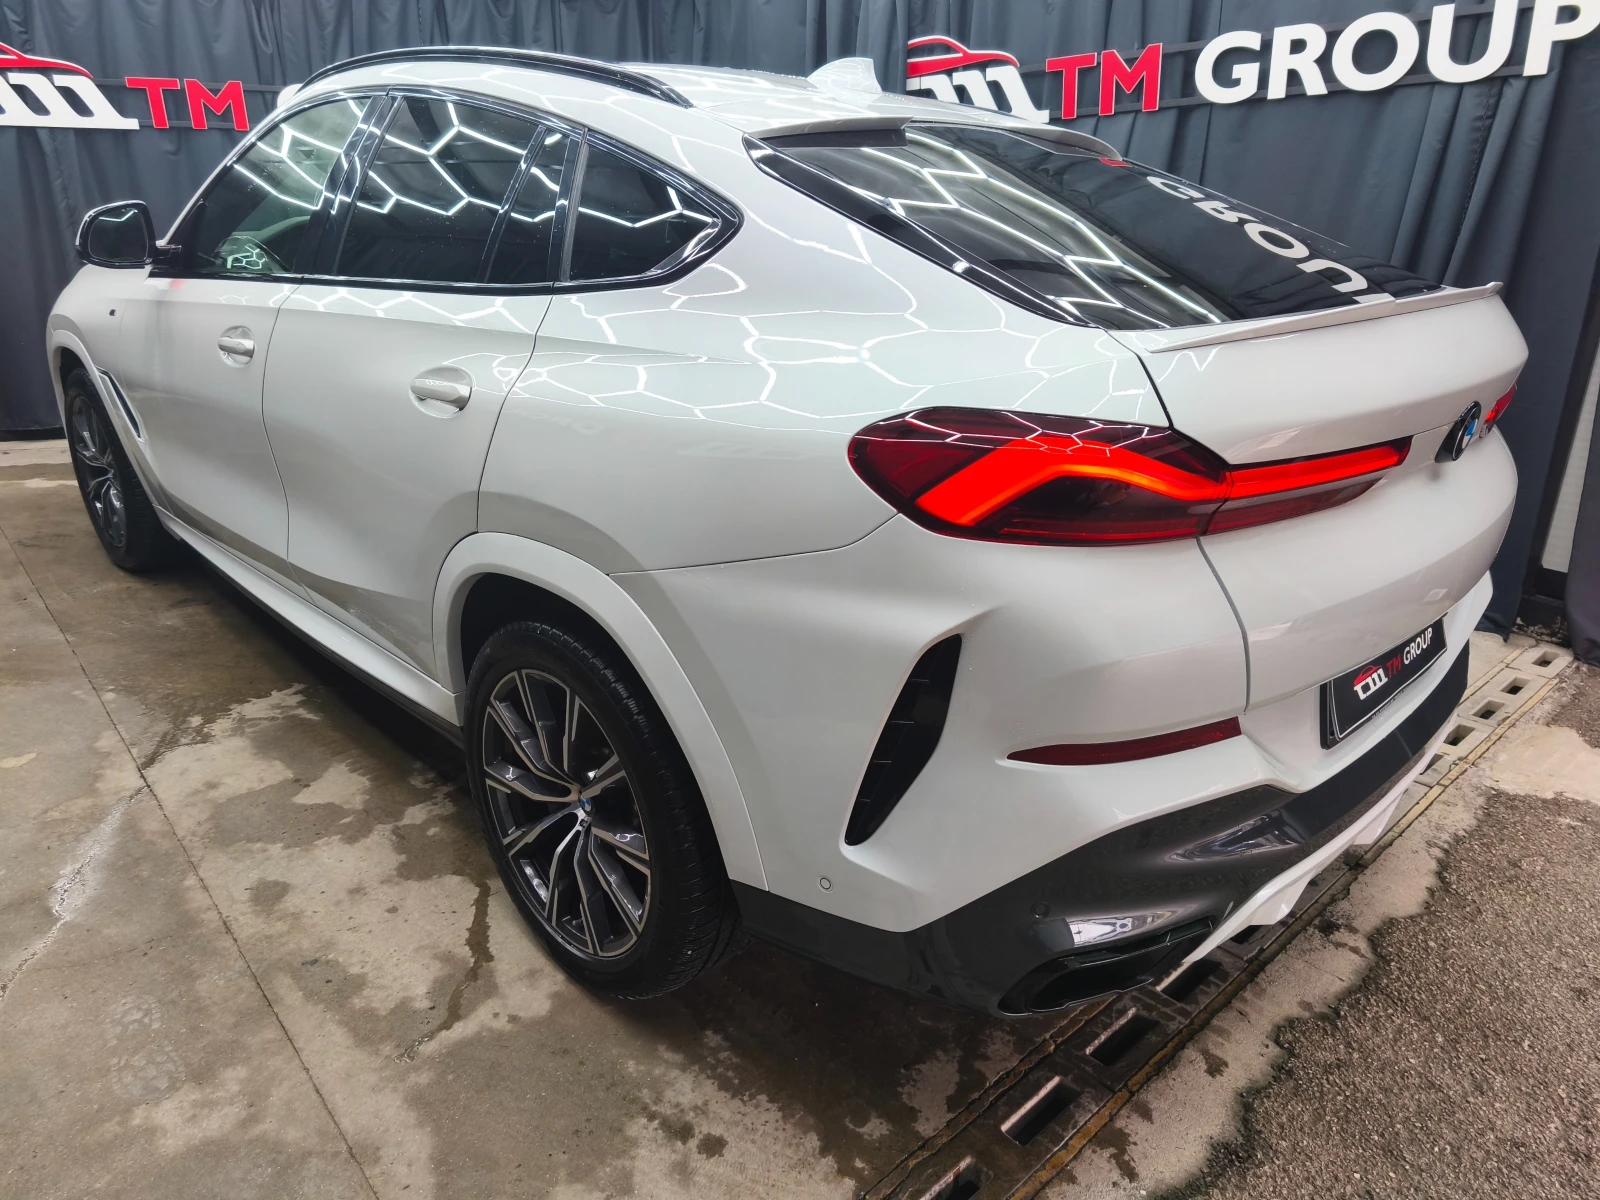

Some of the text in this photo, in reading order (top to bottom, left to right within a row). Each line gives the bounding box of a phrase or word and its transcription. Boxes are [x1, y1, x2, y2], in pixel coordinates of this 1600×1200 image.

[1046, 0, 1600, 119] TM GROUP
[125, 77, 249, 131] TM
[1386, 627, 1433, 678] TM GROUP
